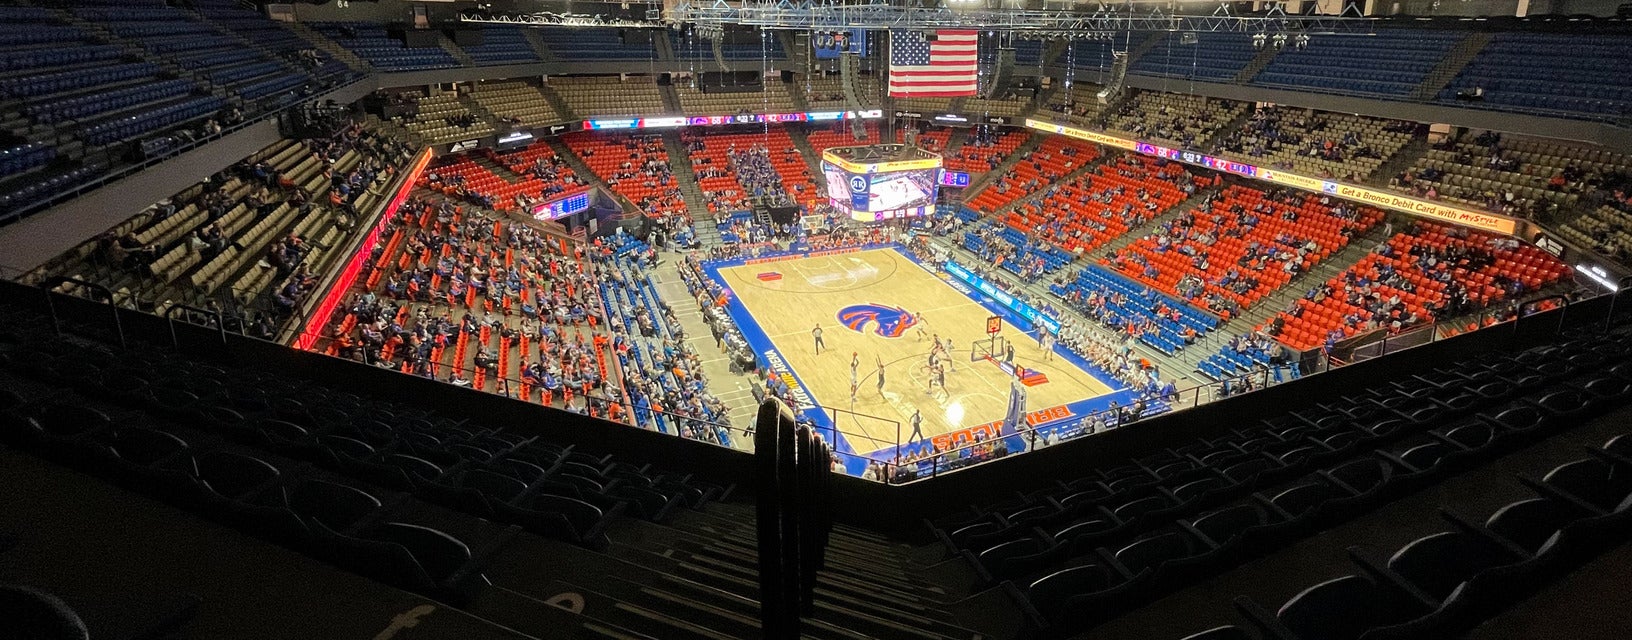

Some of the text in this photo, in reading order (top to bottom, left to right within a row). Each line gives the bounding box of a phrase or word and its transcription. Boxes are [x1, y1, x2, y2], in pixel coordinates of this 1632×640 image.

[1157, 146, 1167, 158] 68
[1216, 159, 1227, 171] 42
[1341, 187, 1355, 197] Get
[1363, 190, 1389, 205] Bronco
[1391, 197, 1414, 210] Debit
[1415, 203, 1436, 214] Card
[1438, 209, 1457, 219] with
[763, 348, 790, 373] ARENA
